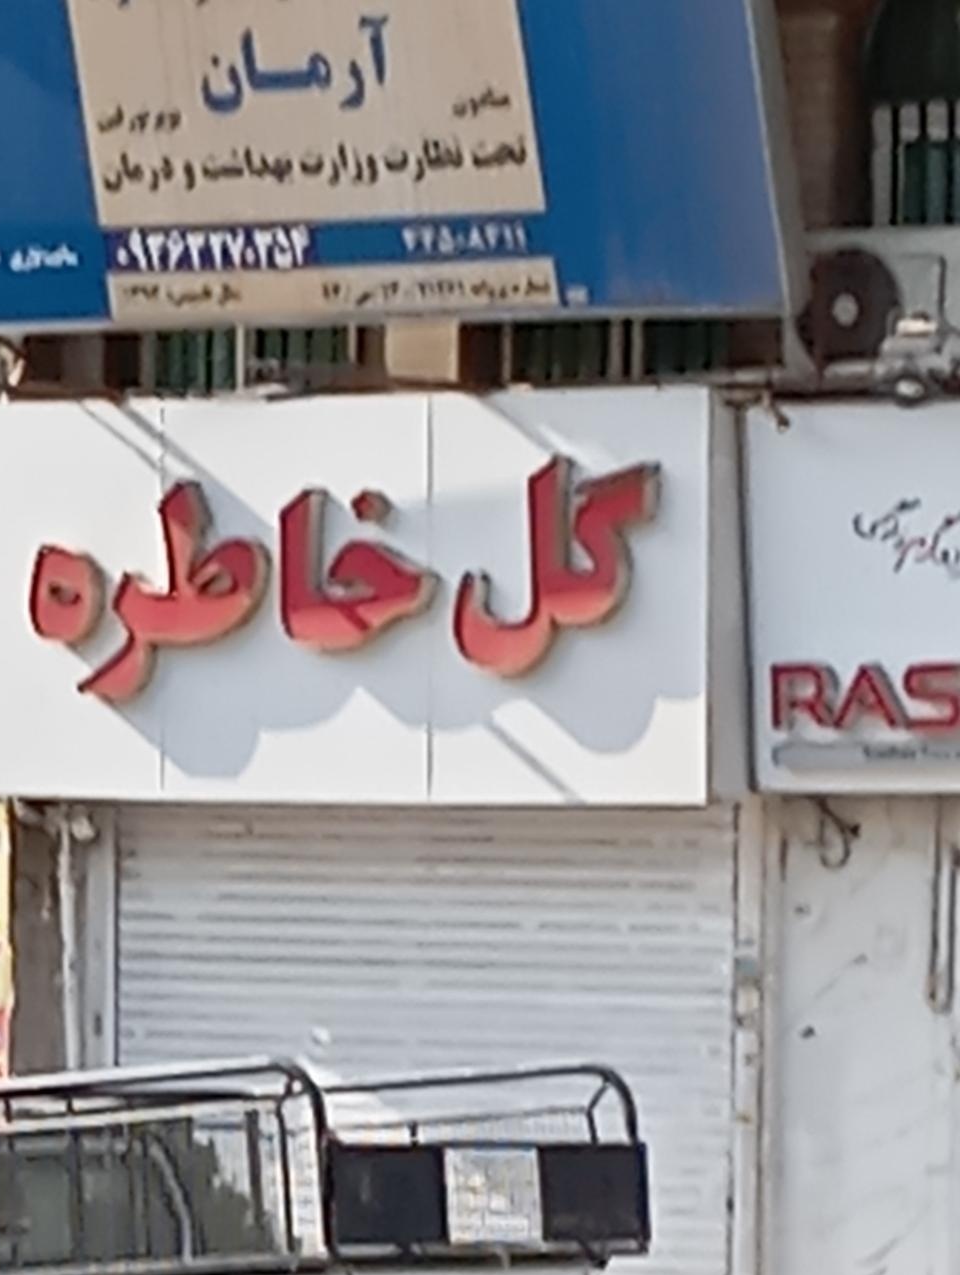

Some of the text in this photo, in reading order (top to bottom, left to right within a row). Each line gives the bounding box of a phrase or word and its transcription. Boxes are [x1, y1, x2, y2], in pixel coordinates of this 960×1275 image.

[202, 15, 389, 111] آرمان
[102, 136, 527, 194] تحت نظارت وزارت بهداشت و درمان
[28, 454, 662, 703] گل خاطره
[770, 662, 960, 732] RAS
